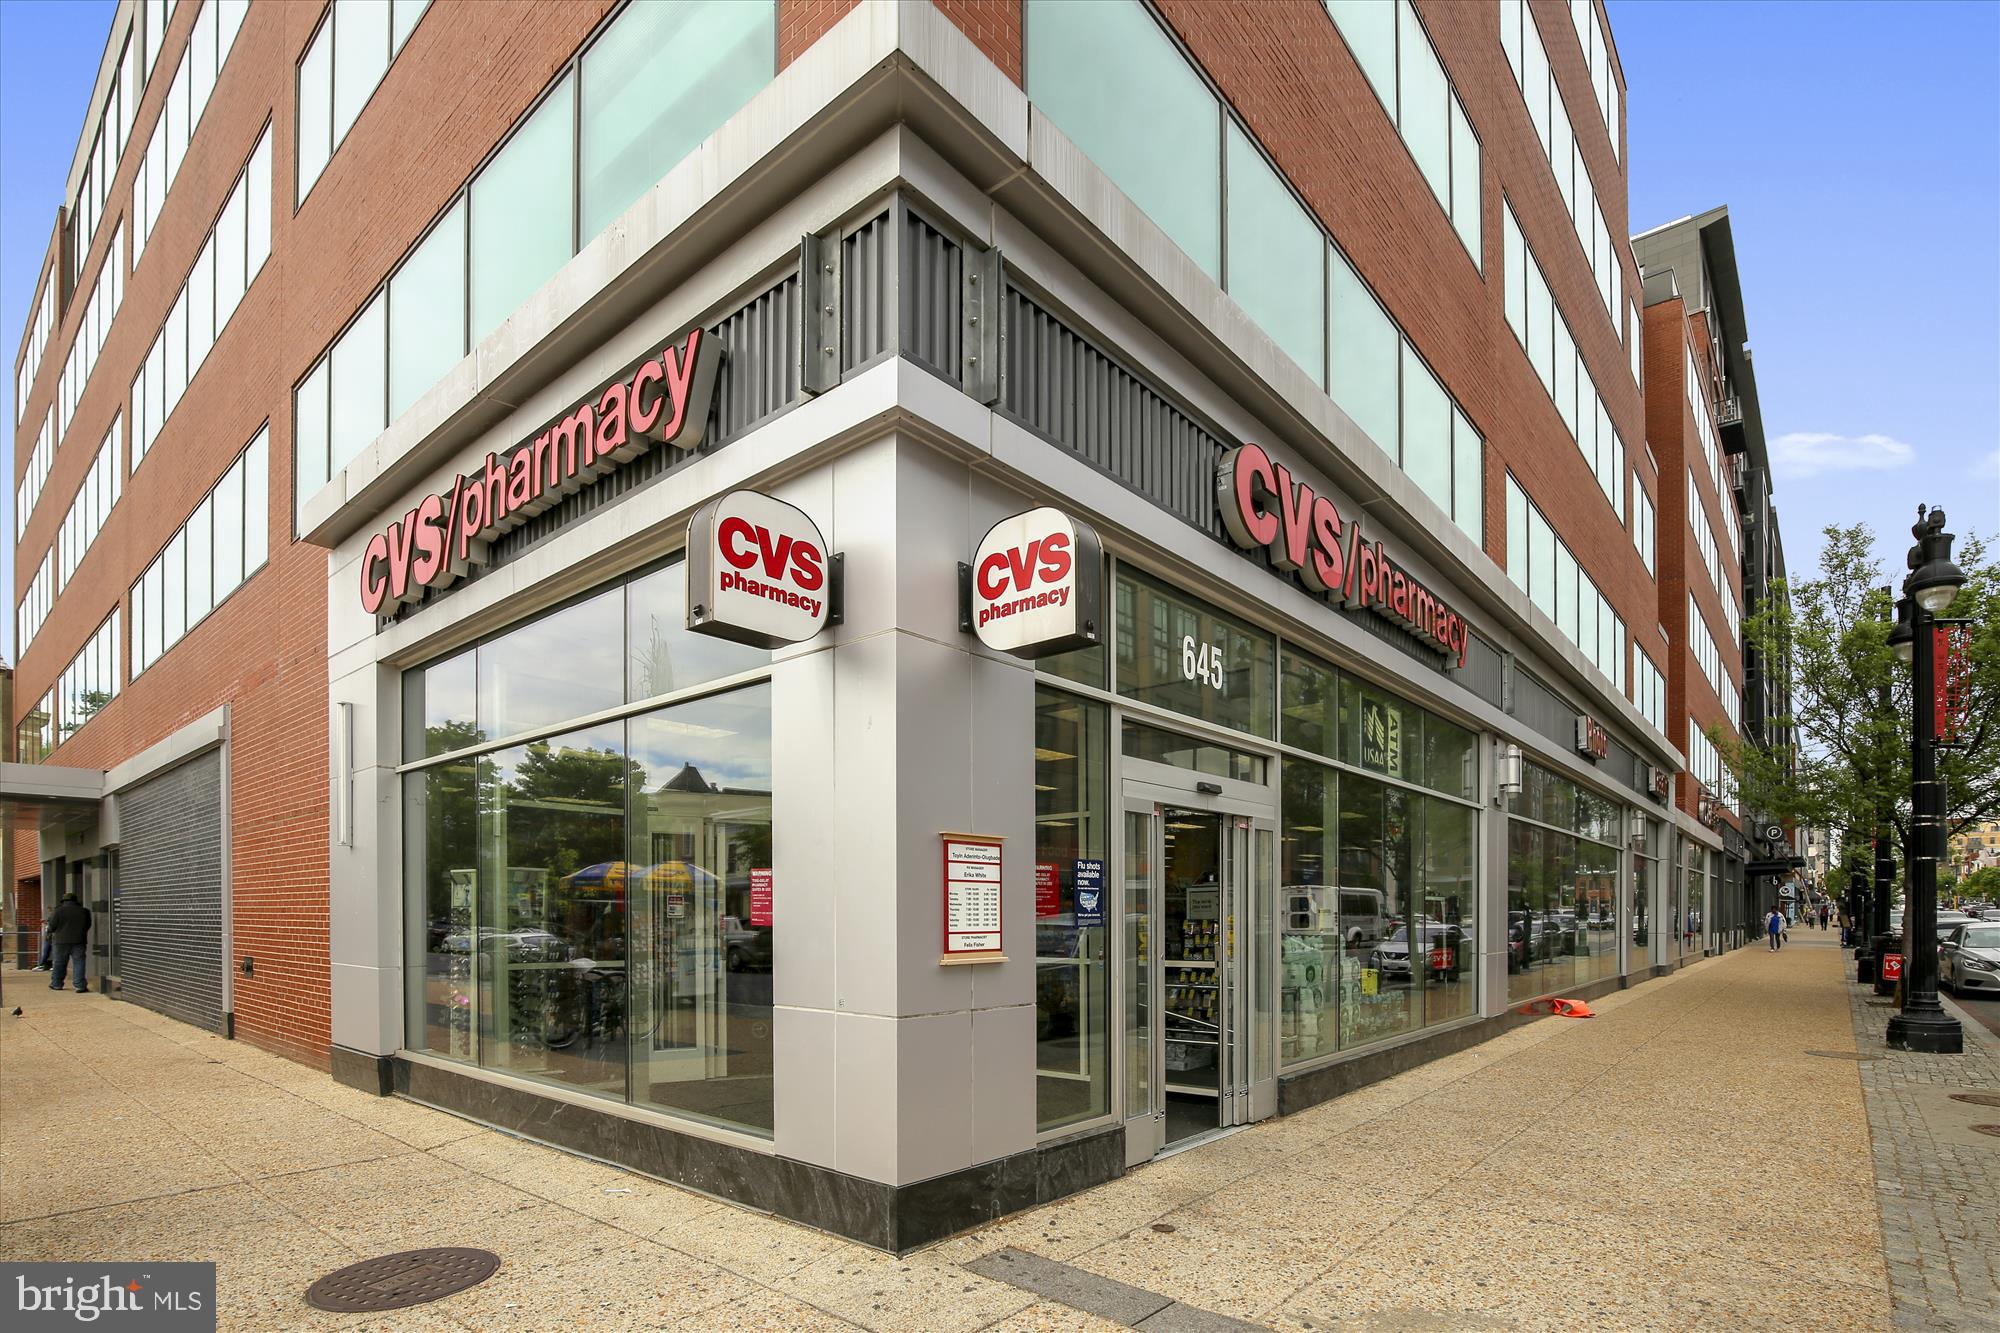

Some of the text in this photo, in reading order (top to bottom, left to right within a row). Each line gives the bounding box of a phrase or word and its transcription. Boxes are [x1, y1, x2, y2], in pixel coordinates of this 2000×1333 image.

[361, 327, 705, 614] CVS/pharmacy
[718, 517, 823, 591] CVS
[977, 532, 1071, 600] CVS
[1233, 443, 1468, 669] CVS/pharmacy
[720, 571, 822, 618] pharmacy
[979, 586, 1070, 628] pharmacy
[1182, 635, 1223, 690] 645
[1363, 746, 1385, 768] USAA
[1390, 713, 1399, 772] ATM
[1077, 861, 1100, 870] Flu shots
[1077, 871, 1100, 879] available
